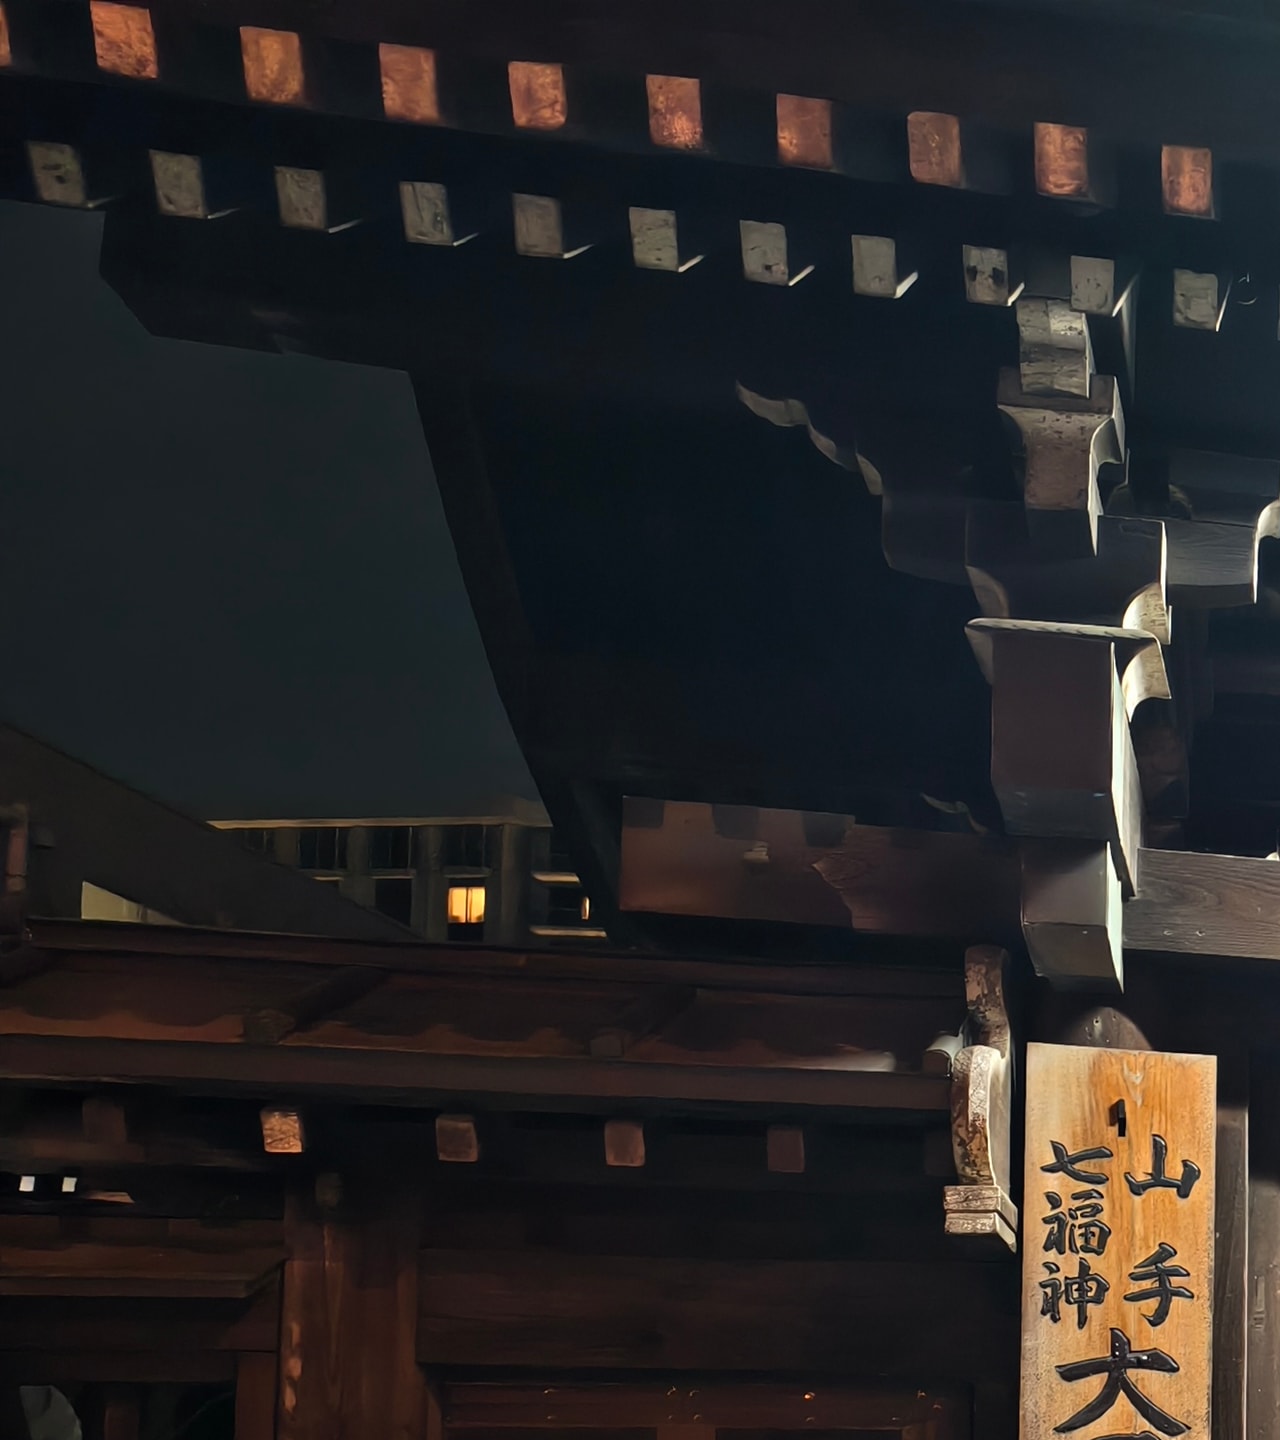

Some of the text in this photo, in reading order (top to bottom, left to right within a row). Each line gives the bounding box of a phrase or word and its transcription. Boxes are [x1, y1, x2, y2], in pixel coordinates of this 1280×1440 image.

[1039, 1139, 1114, 1330] 七福神
[1123, 1133, 1201, 1328] 山手
